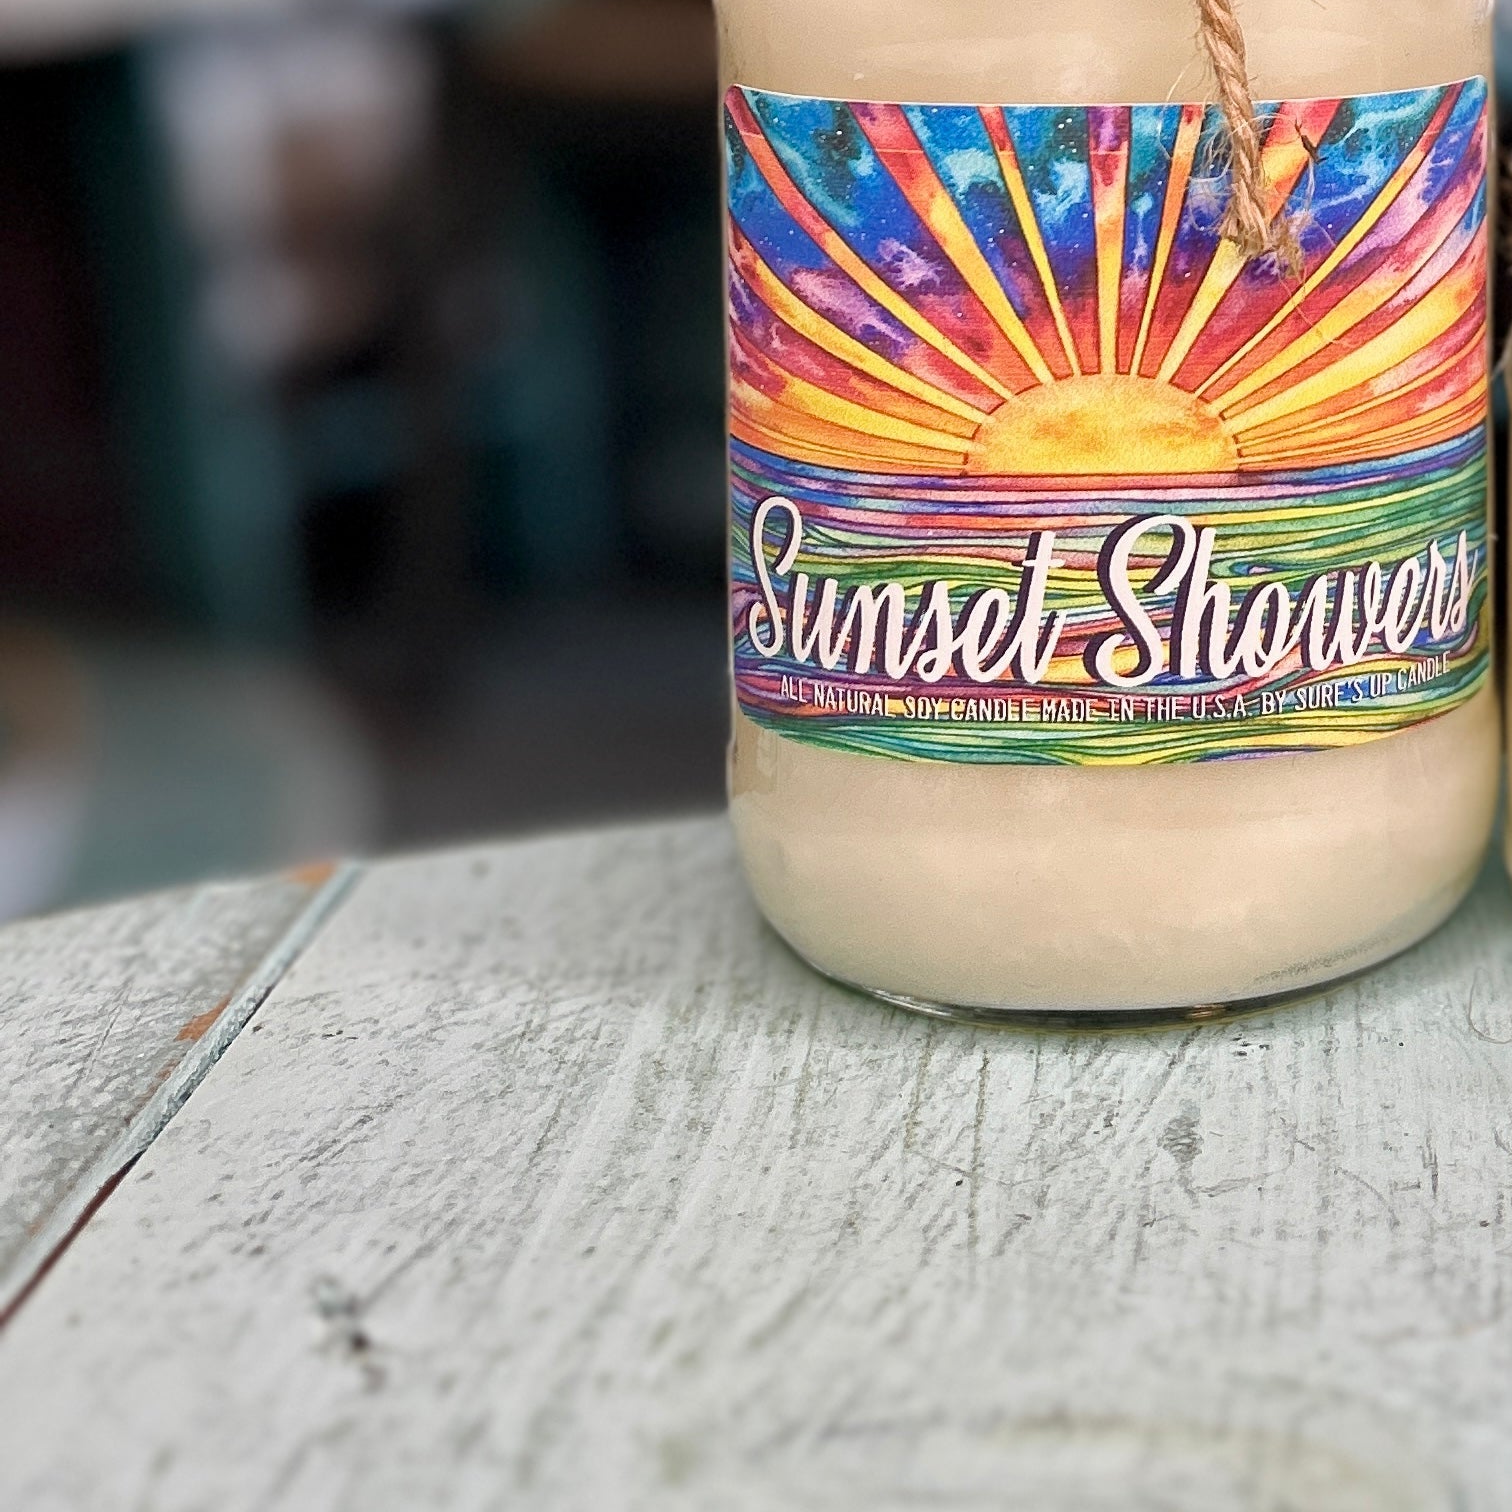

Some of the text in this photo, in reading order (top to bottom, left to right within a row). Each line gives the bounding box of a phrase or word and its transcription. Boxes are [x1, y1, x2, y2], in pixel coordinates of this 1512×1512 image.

[749, 496, 1478, 686] Sunset Showers
[780, 675, 806, 704] ALL
[814, 685, 896, 718] NATURAL
[904, 695, 942, 720] SOY
[951, 698, 1030, 722] CANDLE
[1042, 699, 1098, 723] MADE
[1110, 699, 1134, 722] IN
[1146, 697, 1183, 721] THE
[1193, 694, 1252, 720] U.S.A.
[1261, 690, 1286, 715] BY
[1371, 672, 1392, 697] UP
[1398, 651, 1450, 691] CANDLE
